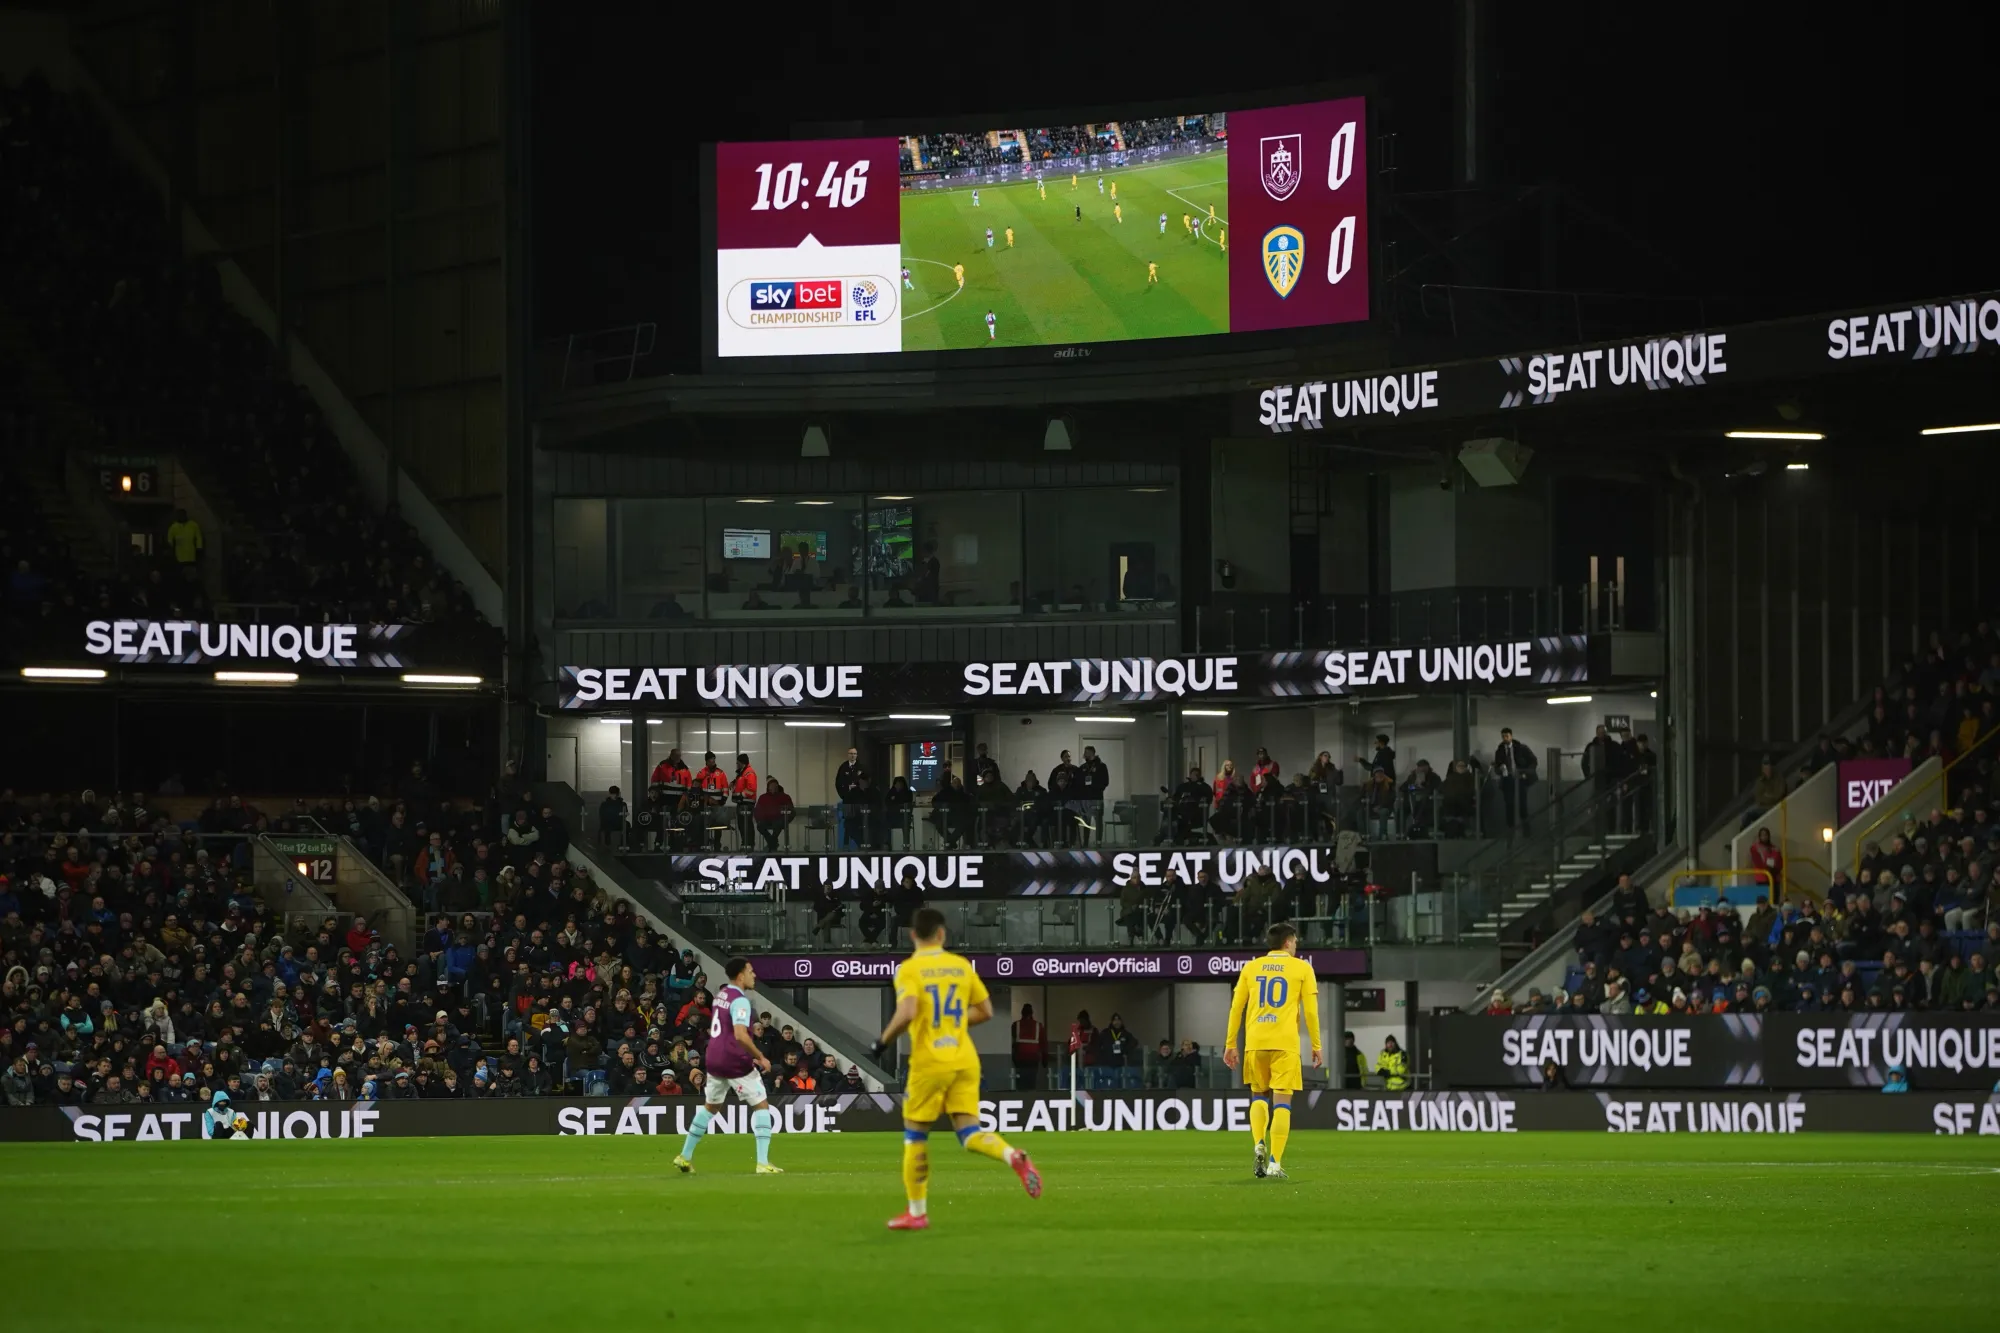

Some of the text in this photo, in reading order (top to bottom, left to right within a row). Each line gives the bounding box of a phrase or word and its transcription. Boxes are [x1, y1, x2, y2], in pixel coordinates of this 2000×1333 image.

[1328, 121, 1356, 191] 0
[751, 160, 870, 210] 10:46
[1327, 216, 1356, 285] 0
[756, 284, 837, 308] sky bet
[750, 311, 842, 325] CHAMPIONSHIP
[855, 310, 876, 321] EFL
[1828, 310, 1912, 360] SEAT
[1053, 347, 1093, 358] adi.tv
[1528, 333, 1727, 395] SEAT UNIQUE
[1259, 370, 1438, 425] SEAT UNIQUE
[137, 472, 151, 492] 6
[85, 621, 357, 663] SEAT UNIQUE
[963, 657, 1238, 697] SEAT UNIQUE
[1324, 641, 1531, 687] SEAT UNIQUE
[576, 665, 863, 703] SEAT UNIQUE
[1848, 779, 1892, 808] EXIT
[296, 843, 307, 853] 12
[310, 860, 332, 880] 12
[698, 855, 984, 891] SEAT UNIQUE
[1112, 848, 1330, 886] SEAT UNIQU
[1032, 957, 1160, 977] @BurnleyOfficial
[1262, 964, 1285, 972] PIROE
[924, 984, 964, 1028] 14
[1255, 975, 1288, 1009] 10
[710, 1008, 722, 1038] 6
[1503, 1028, 1692, 1073] SEAT UNIQUE
[1797, 1028, 2000, 1074] SEAT UNIQUE
[558, 1105, 667, 1135] SEAT
[979, 1097, 1250, 1132] SEAT UNIQUE
[1336, 1099, 1518, 1132] SEAT UNIQUE
[1606, 1101, 1682, 1132] SEAT
[1933, 1102, 2000, 1135] SEA
